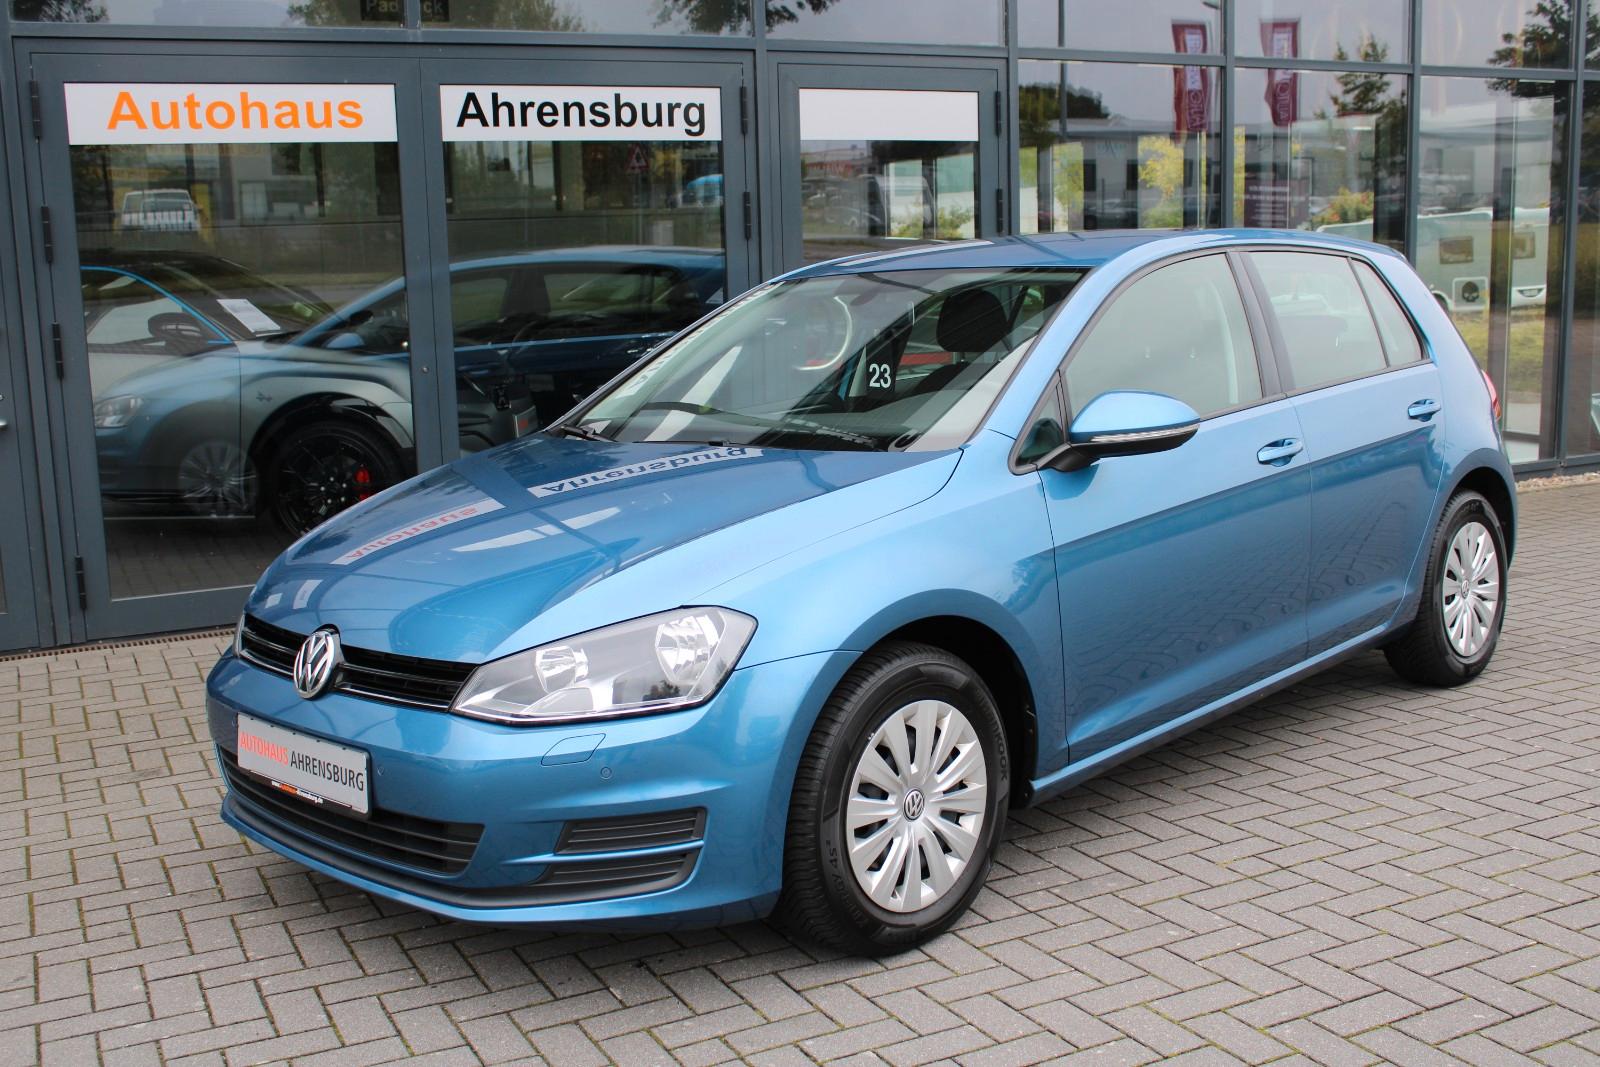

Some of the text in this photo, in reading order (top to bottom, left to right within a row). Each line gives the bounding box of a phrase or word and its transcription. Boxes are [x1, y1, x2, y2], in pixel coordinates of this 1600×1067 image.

[366, 0, 444, 14] Padck
[107, 90, 706, 137] Autohaus Ahrensburg
[869, 363, 892, 388] 23
[240, 731, 364, 791] AUTOHAUS AHRENSBURG
